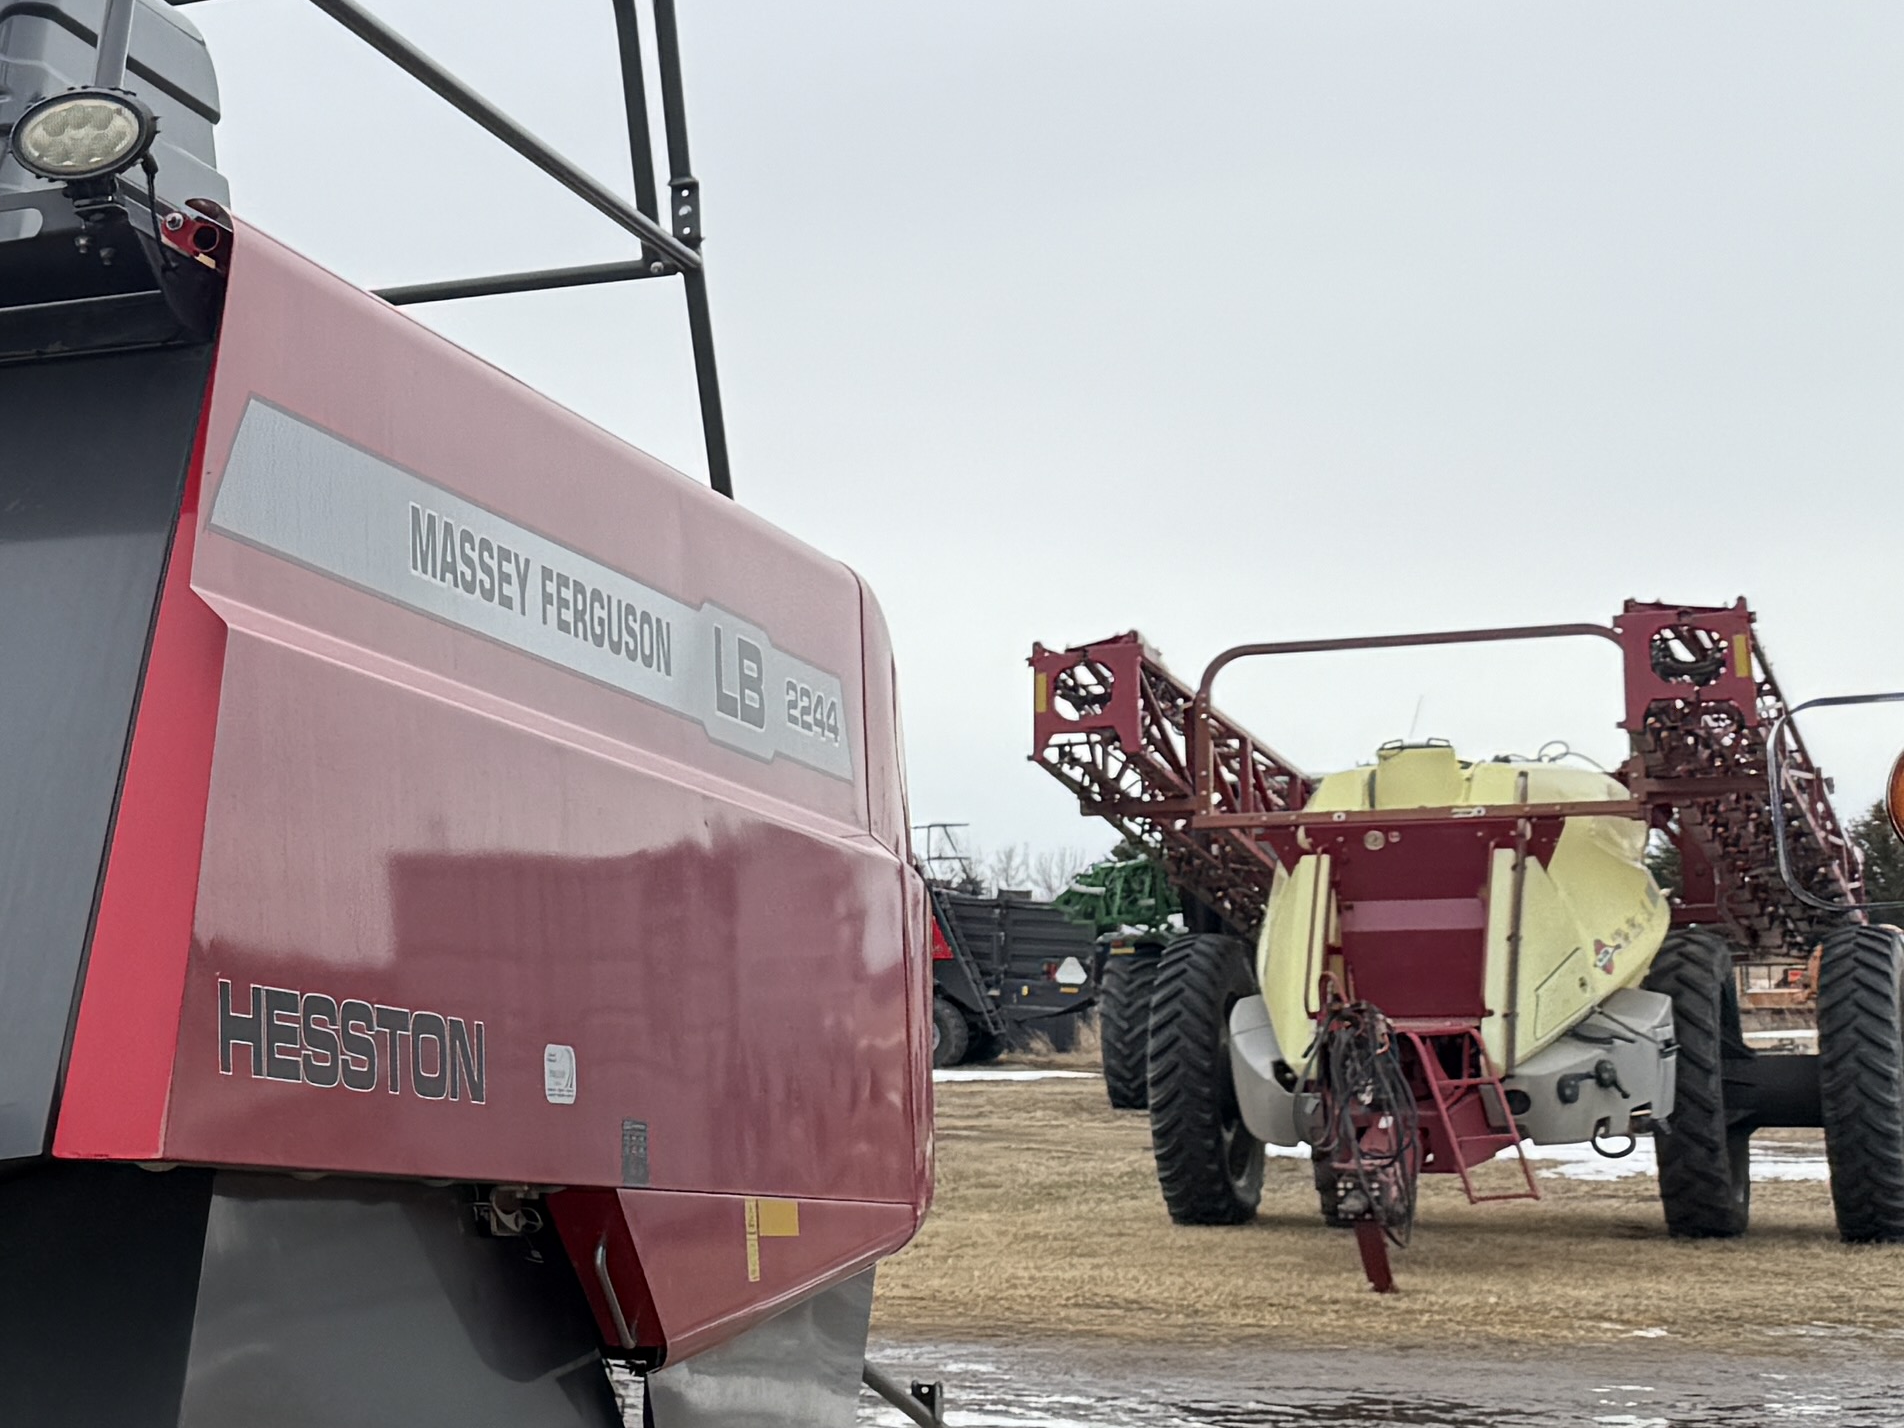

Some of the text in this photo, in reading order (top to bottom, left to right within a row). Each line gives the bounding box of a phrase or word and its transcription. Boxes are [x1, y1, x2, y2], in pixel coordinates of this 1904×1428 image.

[409, 502, 840, 746] MASSEY FERGUSON LB 2244
[218, 978, 485, 1104] HESSTON
